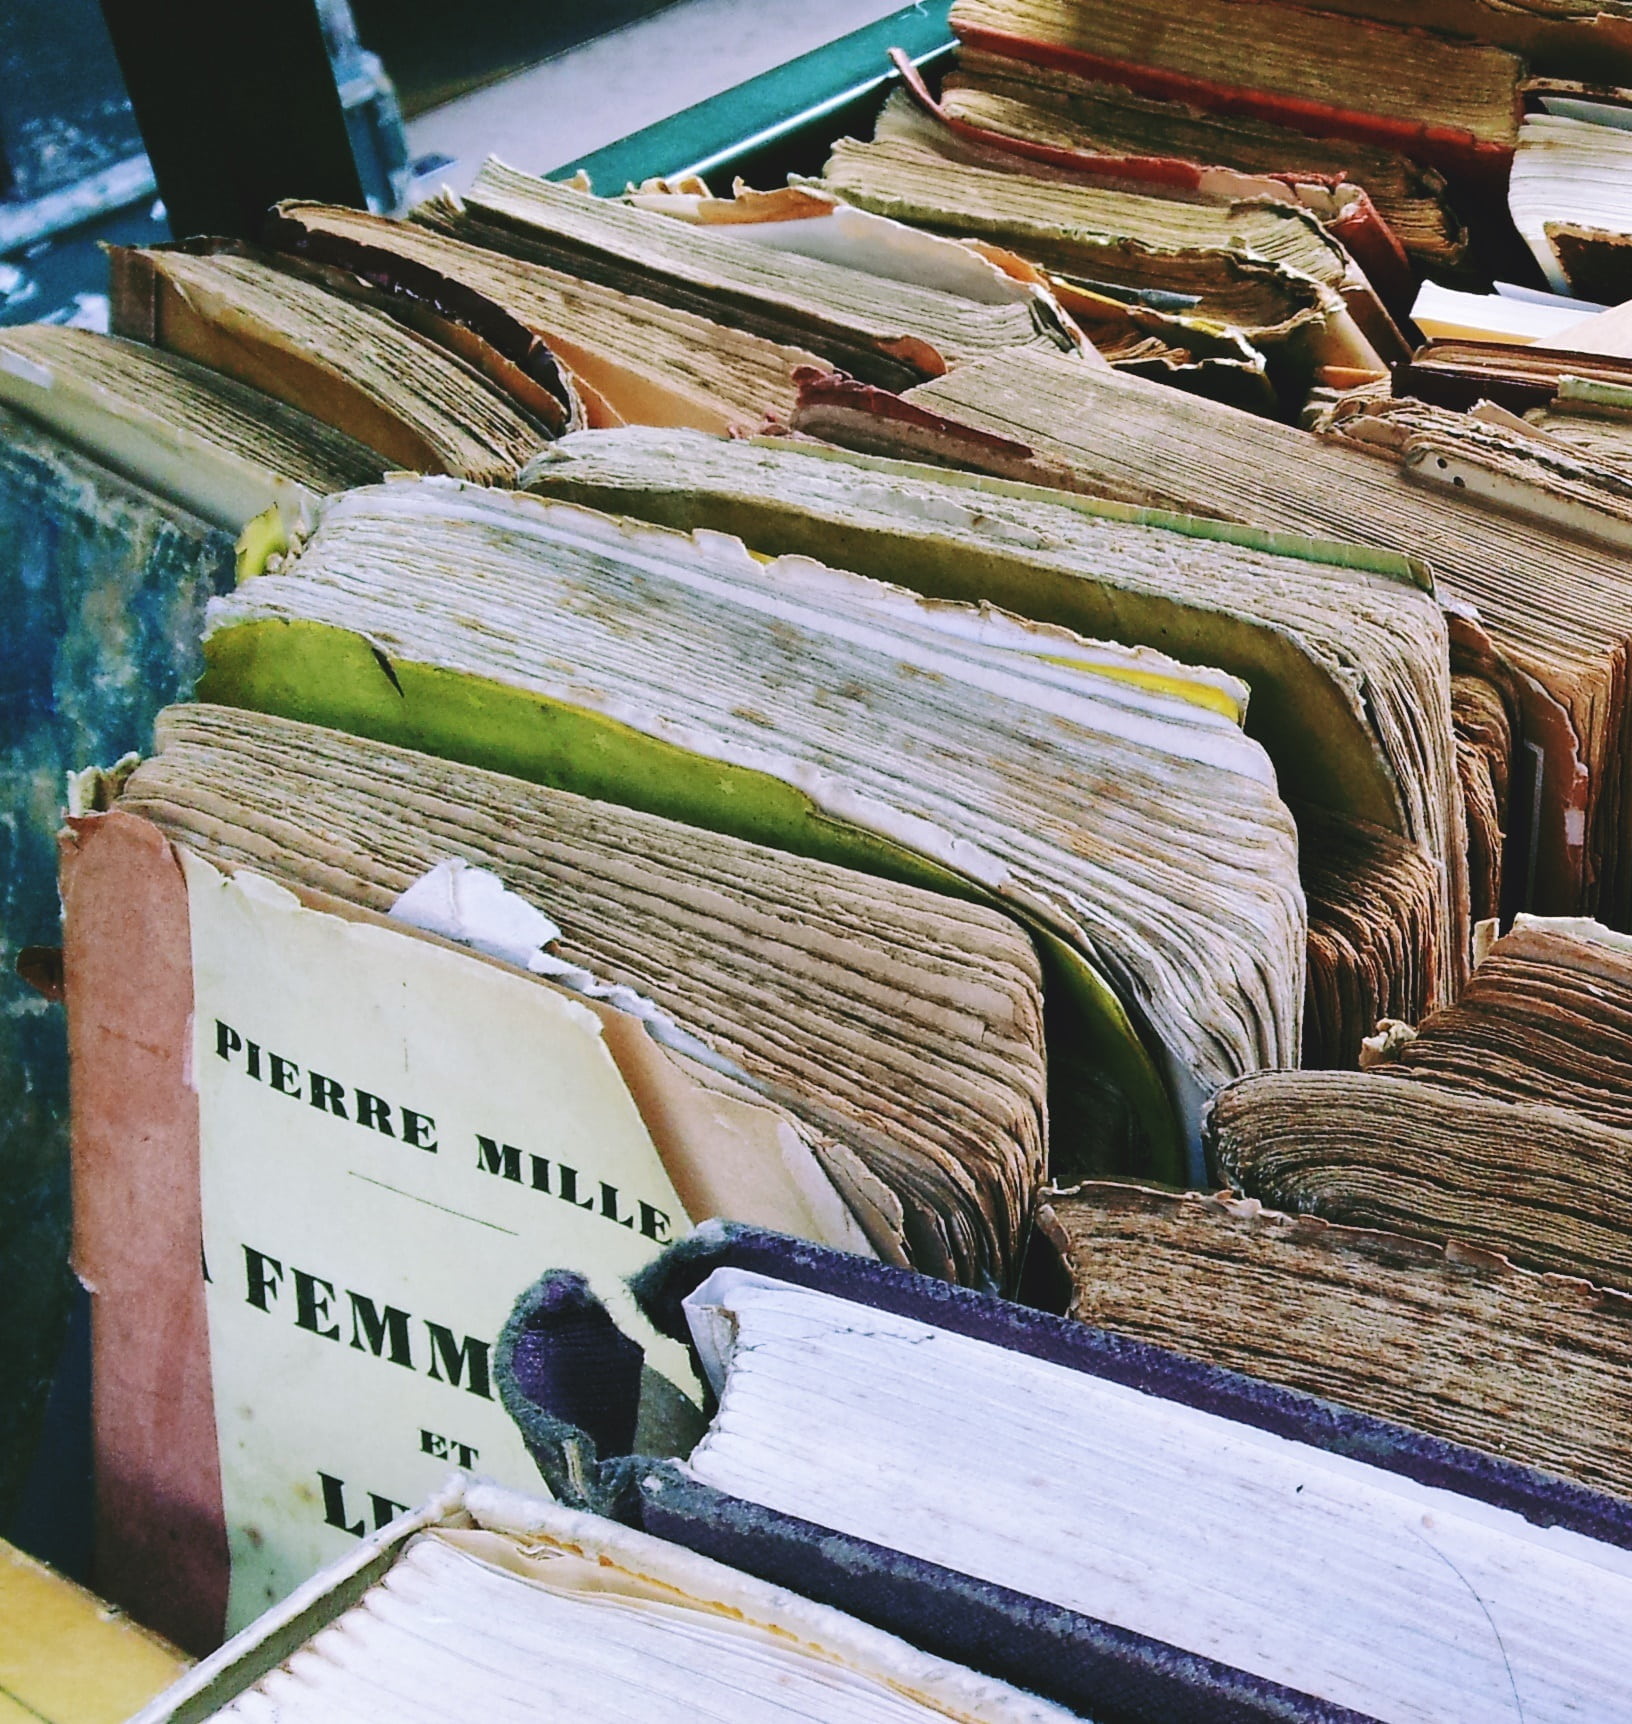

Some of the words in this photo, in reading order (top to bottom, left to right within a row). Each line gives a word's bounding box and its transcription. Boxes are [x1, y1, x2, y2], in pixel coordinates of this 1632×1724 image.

[214, 1018, 439, 1154] PIERRE
[474, 1134, 673, 1246] MILLE
[241, 1243, 496, 1402] FEMM
[418, 1427, 480, 1472] ET
